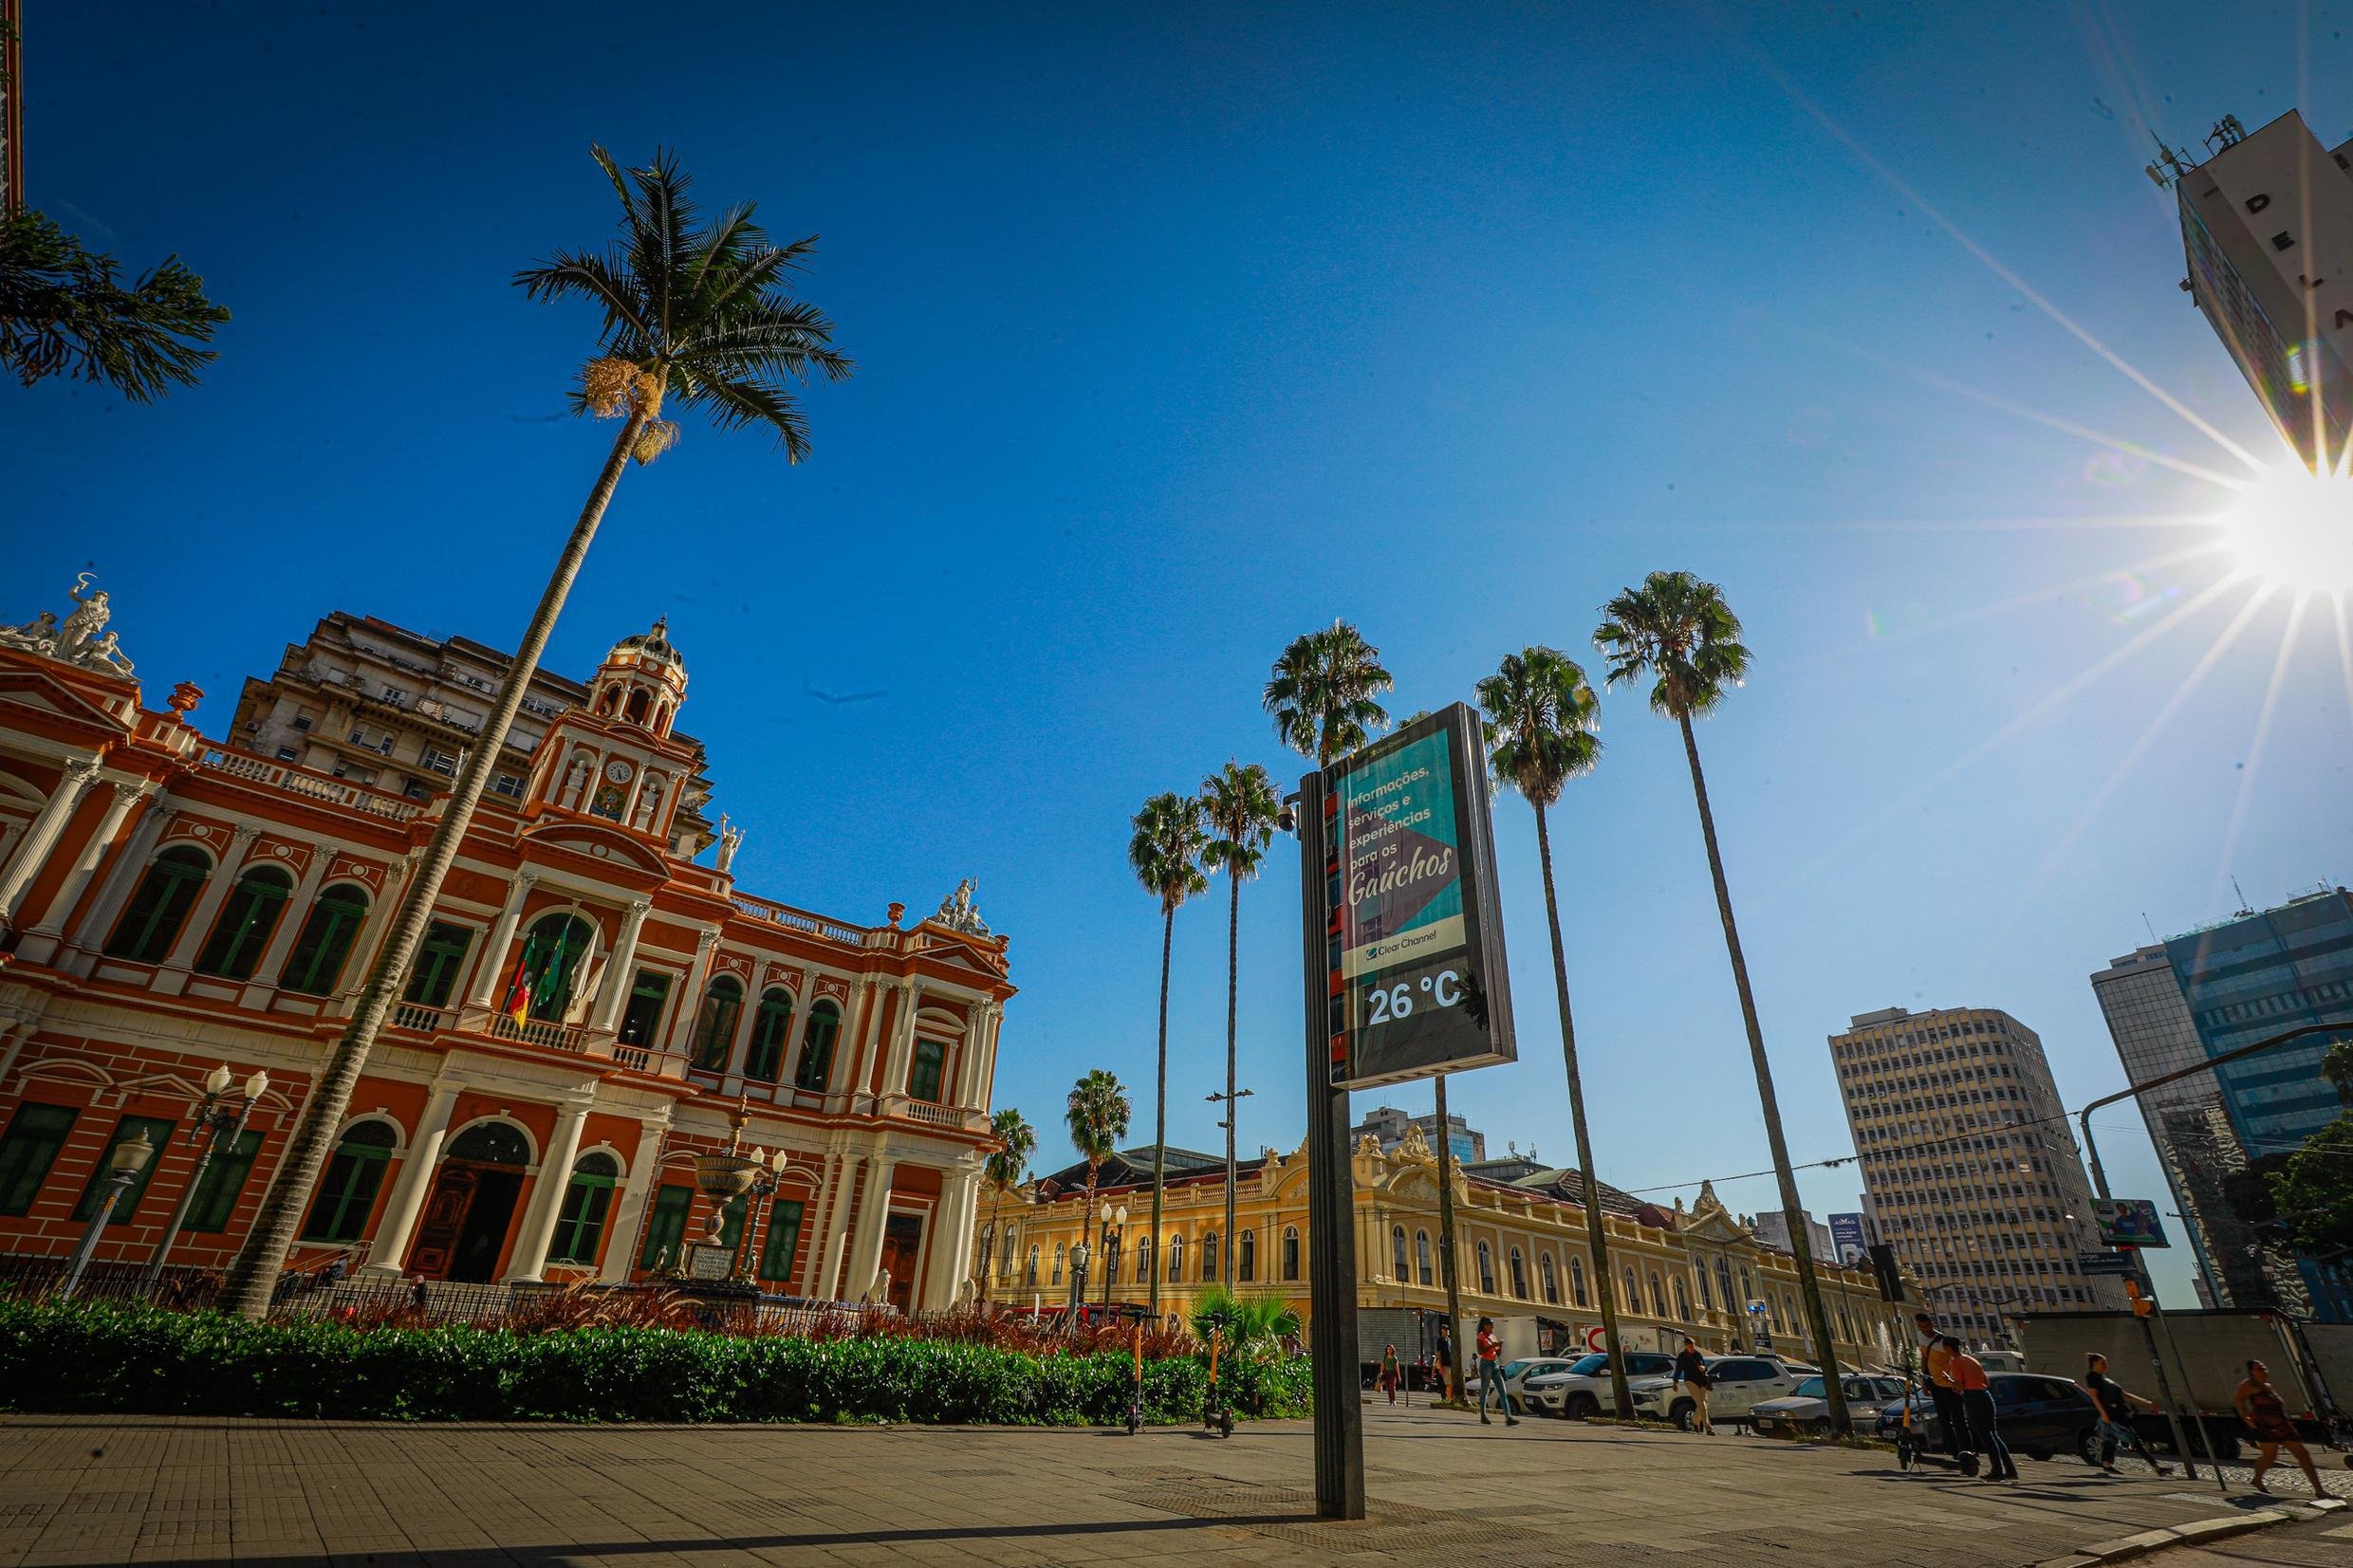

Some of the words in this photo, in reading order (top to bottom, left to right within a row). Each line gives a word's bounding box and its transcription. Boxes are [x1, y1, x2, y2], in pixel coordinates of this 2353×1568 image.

[1347, 766, 1429, 809] Informações,
[1348, 800, 1399, 829] serviços
[1402, 795, 1411, 805] e
[1349, 808, 1431, 849] experiências
[1348, 846, 1453, 906] Gaúchos
[1350, 851, 1378, 870] para
[1381, 844, 1398, 858] os
[1378, 943, 1399, 955] Clear
[1400, 930, 1436, 949] Channel
[1369, 983, 1413, 1024] 26
[1420, 969, 1461, 1006] °C
